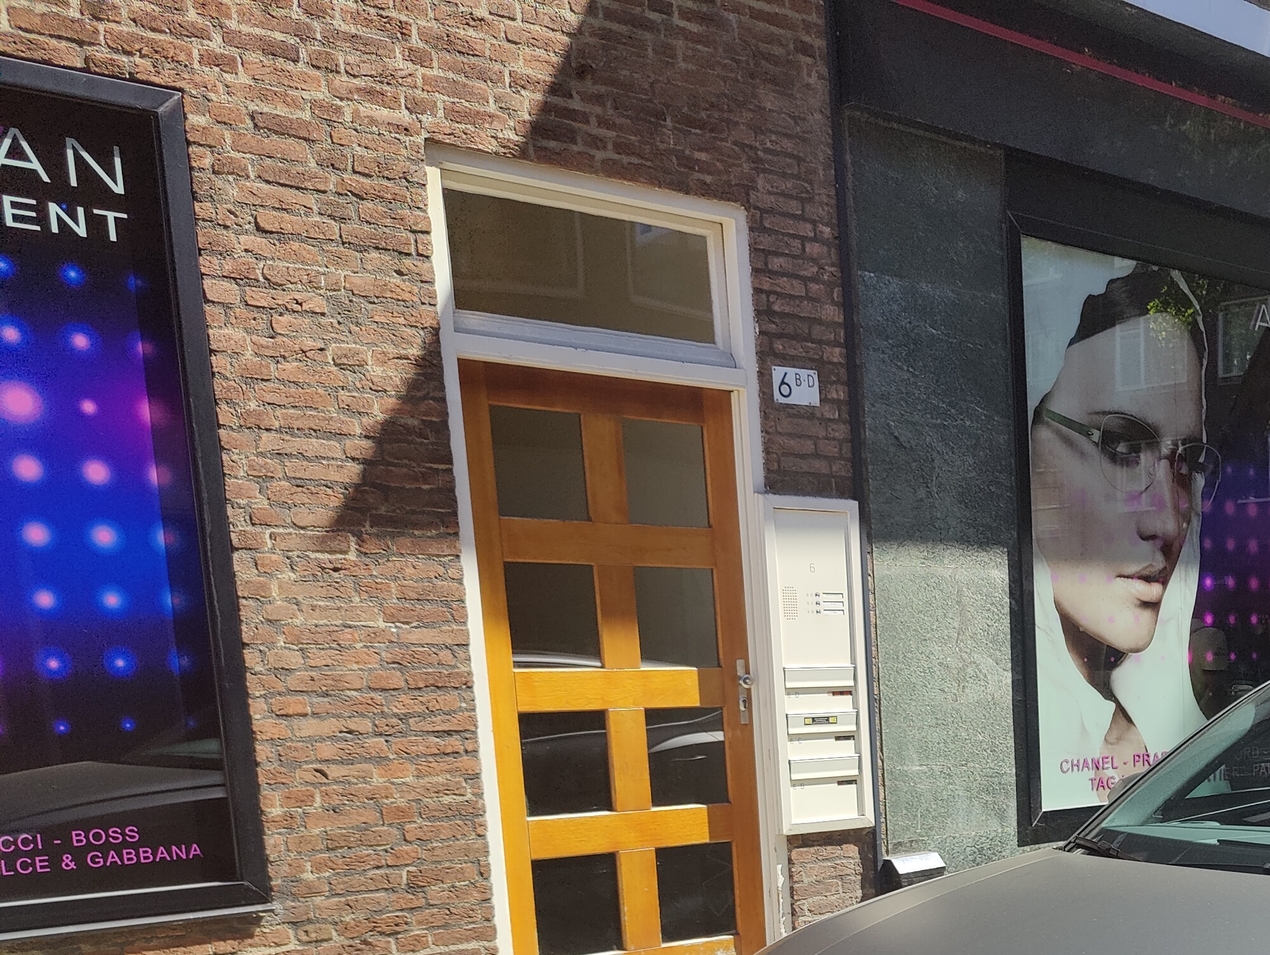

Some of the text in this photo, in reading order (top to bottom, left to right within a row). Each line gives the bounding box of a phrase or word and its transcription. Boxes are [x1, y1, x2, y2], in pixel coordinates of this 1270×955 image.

[778, 371, 792, 399] 6
[1059, 754, 1120, 774] CHANEL
[1088, 775, 1117, 792] TAG
[71, 826, 140, 848] BOSS
[61, 853, 77, 871] &
[86, 843, 204, 869] GABBANA
